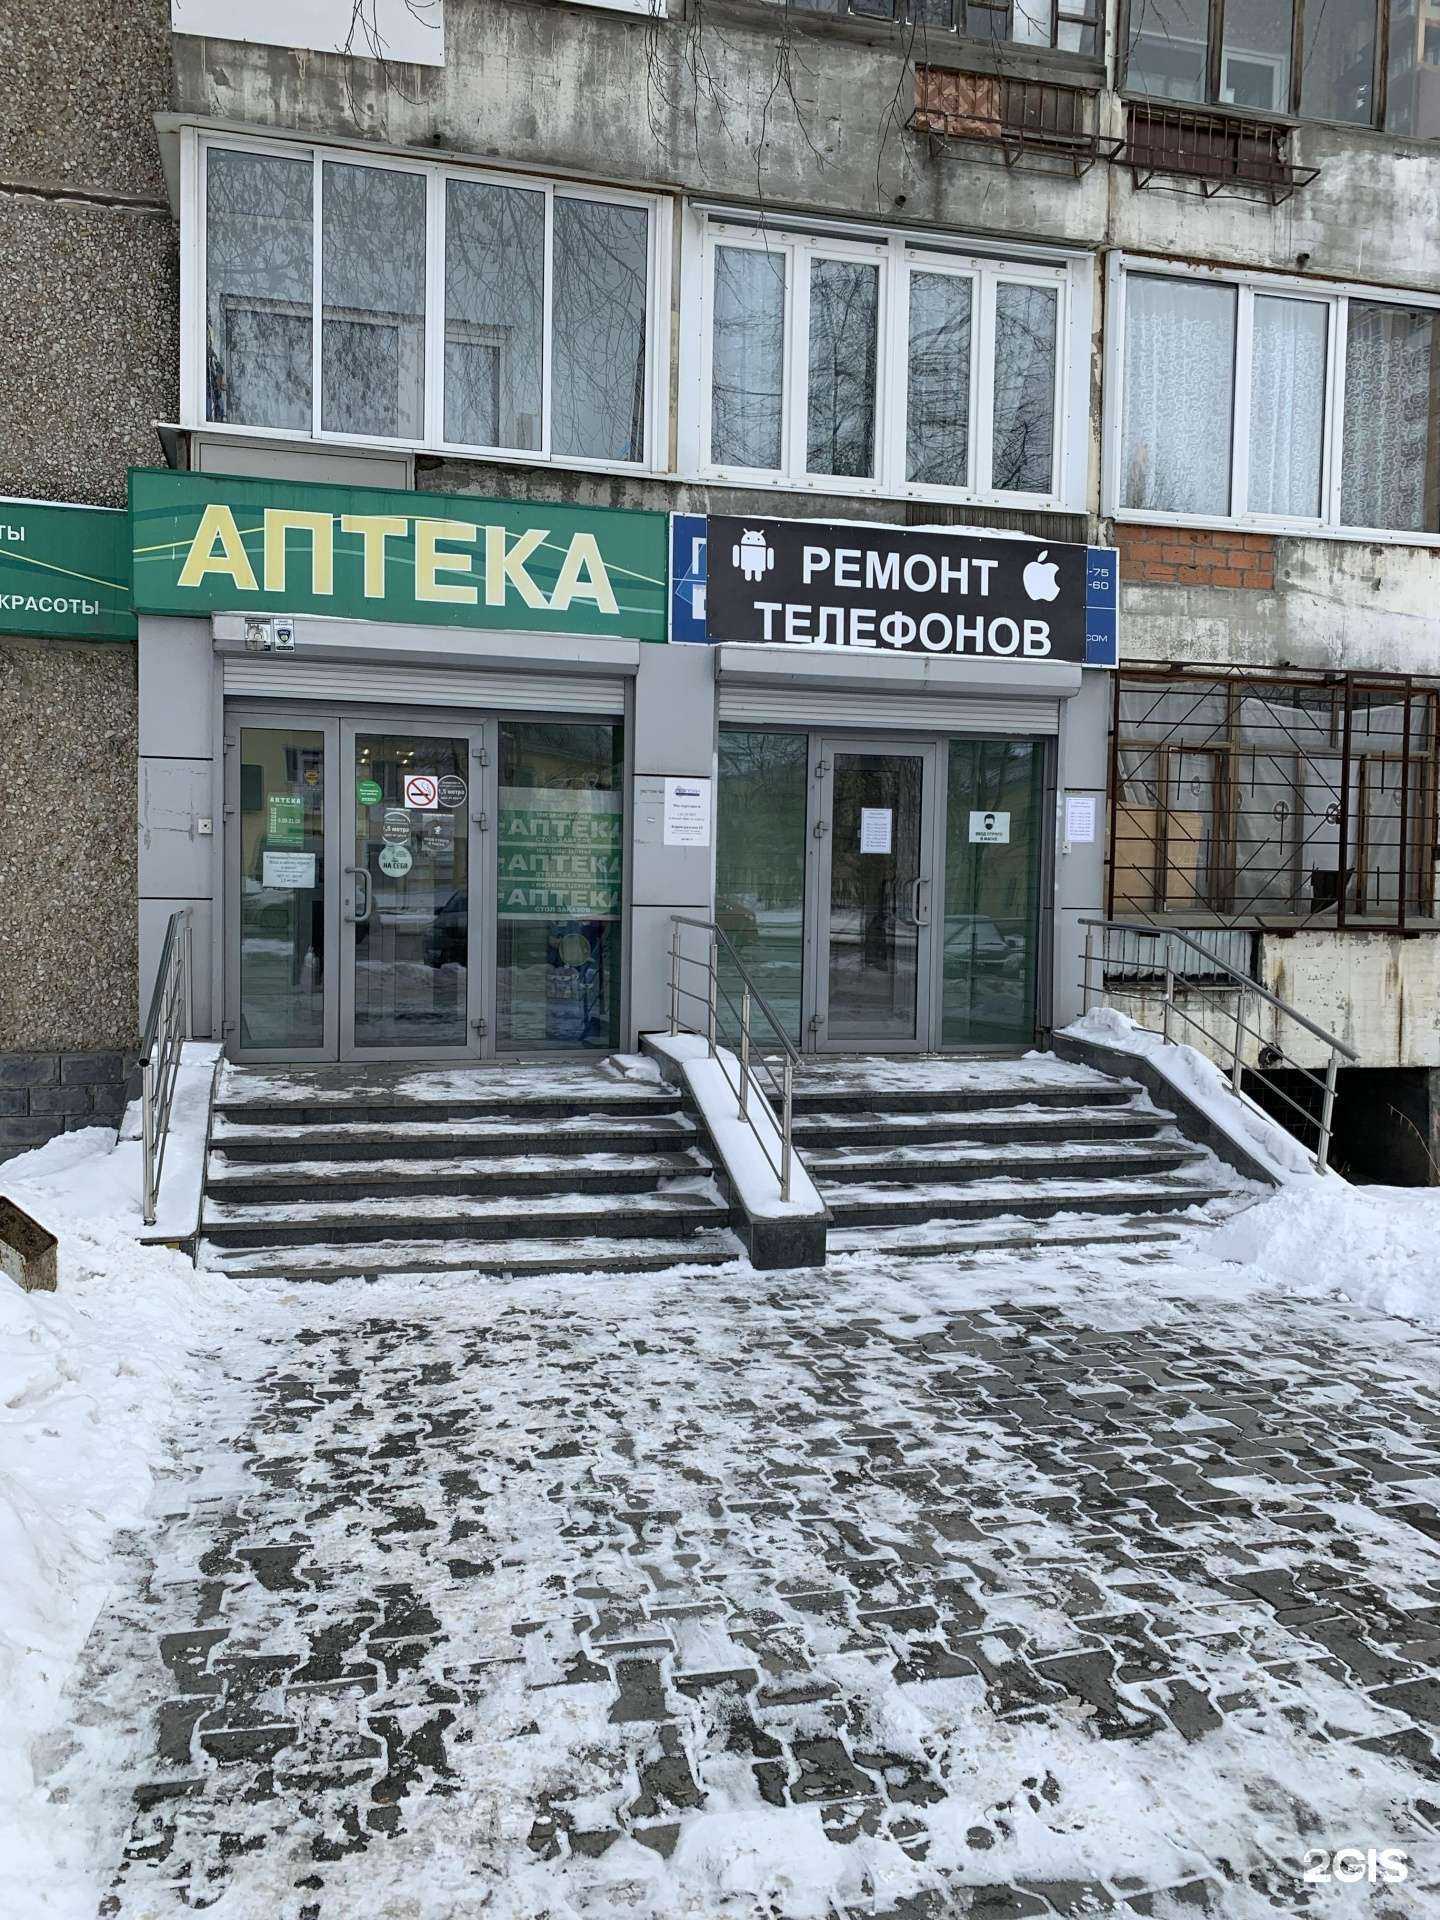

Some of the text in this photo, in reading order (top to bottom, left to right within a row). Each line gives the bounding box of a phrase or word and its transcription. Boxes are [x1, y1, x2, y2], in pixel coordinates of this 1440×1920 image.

[177, 504, 620, 614] АПТЕКА
[803, 546, 998, 597] РЕМОНТ
[0, 594, 99, 615] КРАСОТЫ
[753, 601, 1052, 656] ТЕЛЕФОНОВ
